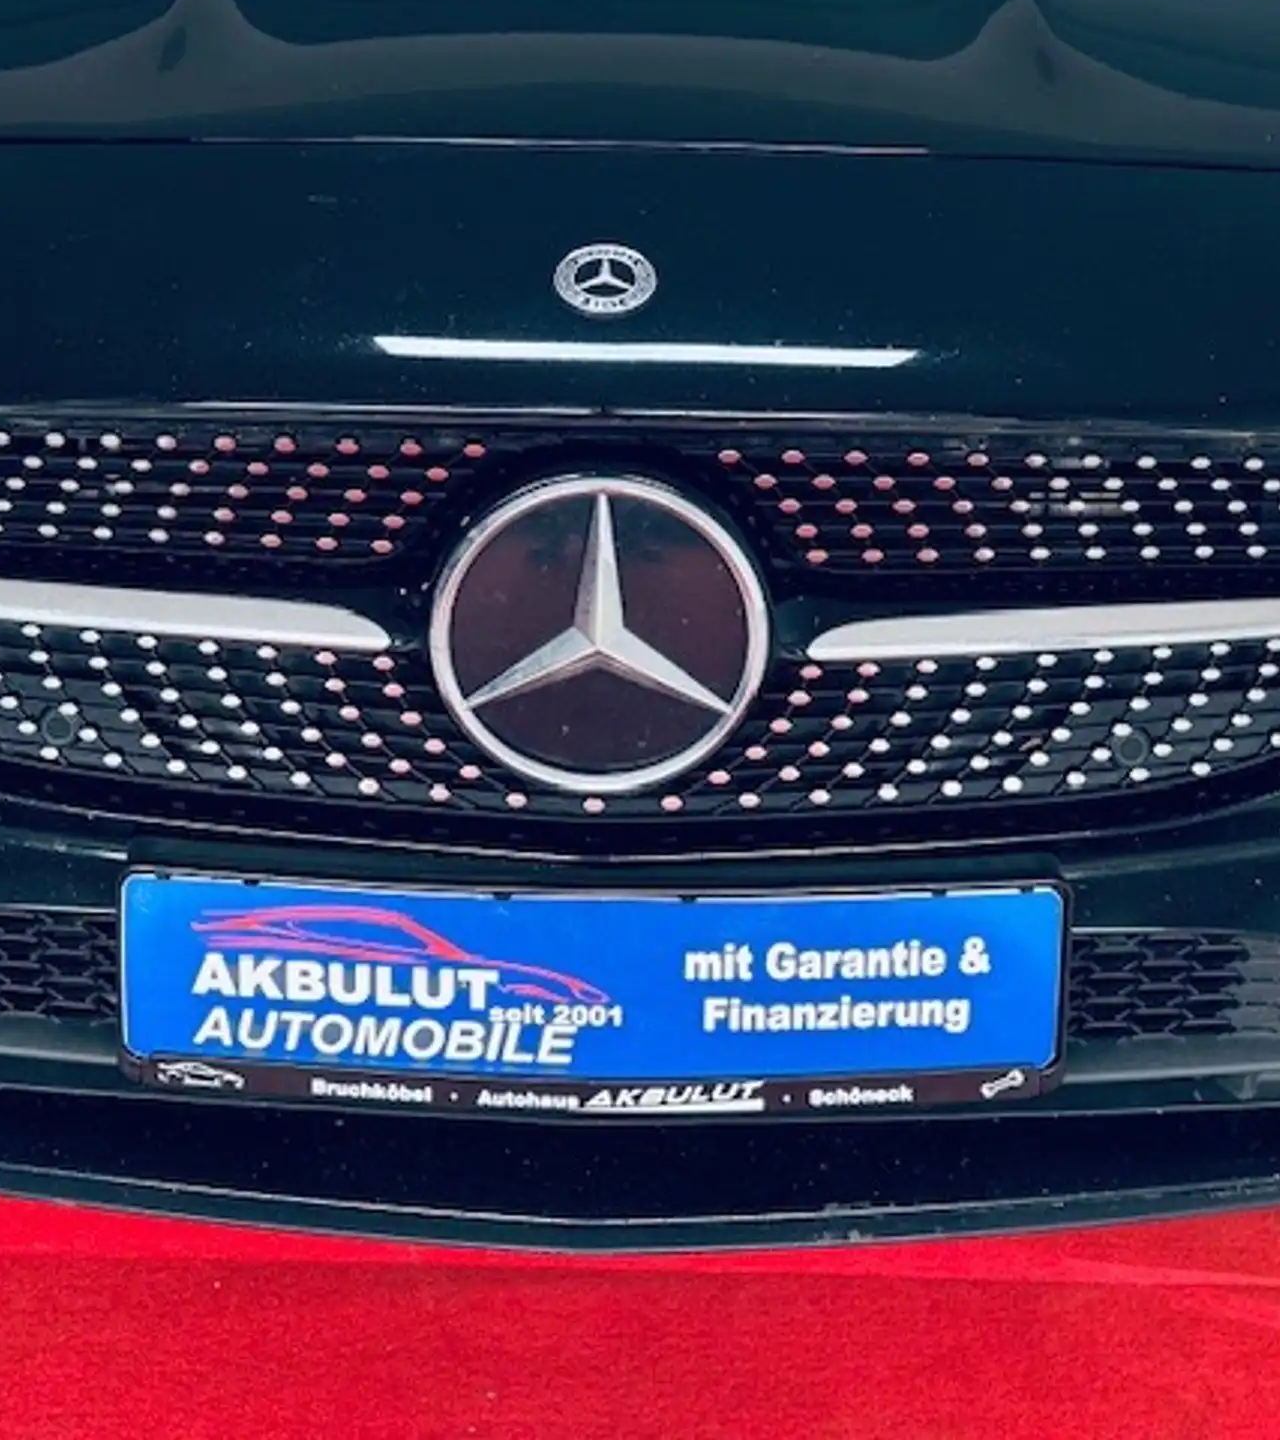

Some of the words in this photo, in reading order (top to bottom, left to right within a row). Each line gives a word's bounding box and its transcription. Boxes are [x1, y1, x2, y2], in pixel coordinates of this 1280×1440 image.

[683, 942, 754, 981] mit
[765, 938, 948, 981] Garantie
[957, 935, 992, 975] &
[191, 951, 500, 1011] AKBULUT
[193, 1006, 580, 1065] AUTOMOBILE
[488, 1004, 546, 1025] seit
[552, 1003, 623, 1028] 2001
[702, 994, 972, 1034] Finanzierung
[477, 1088, 581, 1110] Autohaus
[582, 1078, 766, 1109] AKBULUT
